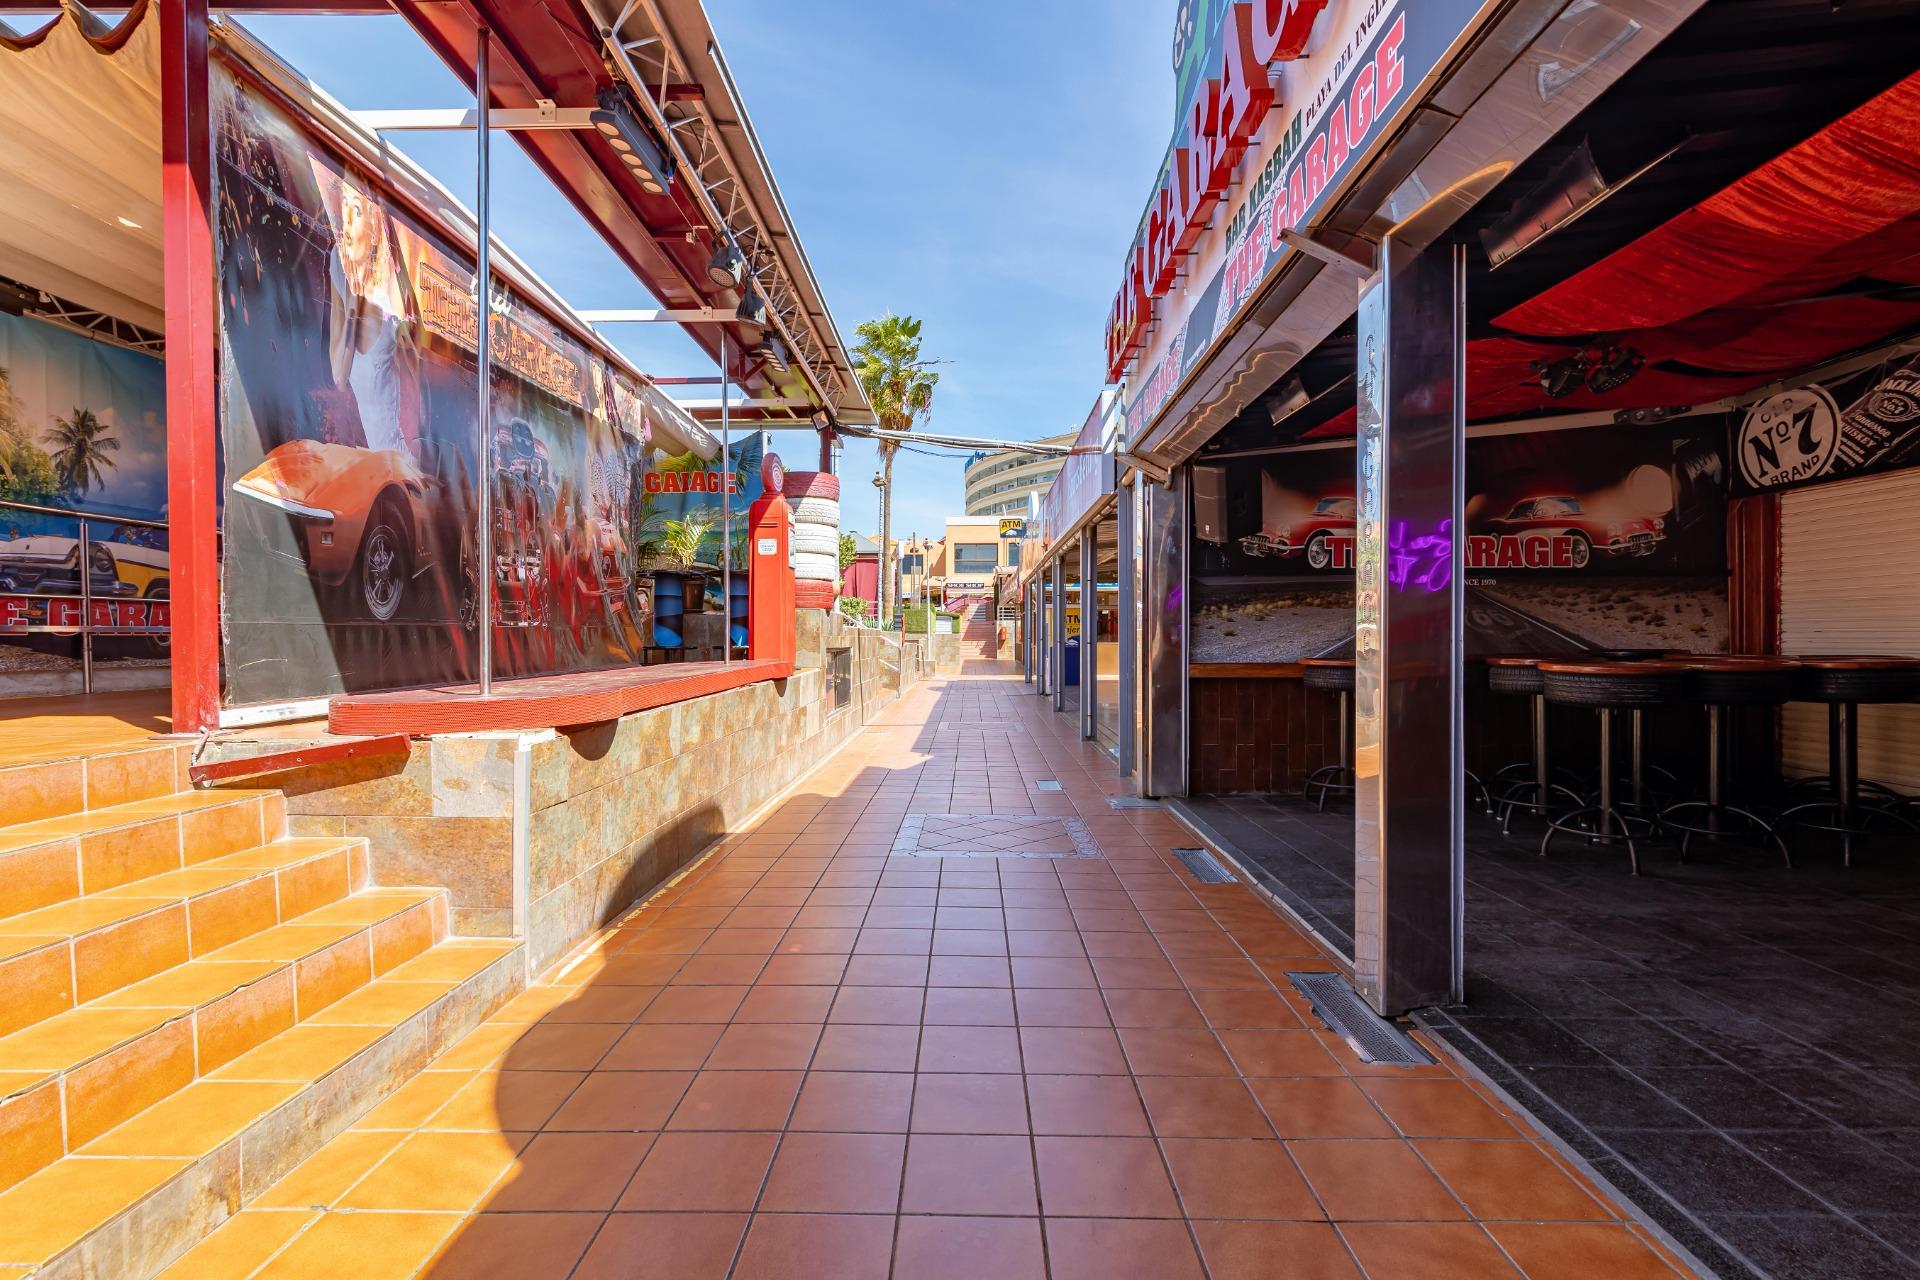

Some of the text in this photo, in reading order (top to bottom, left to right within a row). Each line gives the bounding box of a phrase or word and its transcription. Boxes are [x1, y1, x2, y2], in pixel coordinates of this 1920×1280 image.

[1225, 10, 1406, 310] THE GARAGE
[1226, 202, 1245, 256] BAR
[1249, 108, 1302, 219] KASBAH
[1306, 77, 1332, 127] PLAYA
[1334, 43, 1353, 83] DEL
[1143, 347, 1180, 422] GARAGE
[1770, 454, 1821, 486] BRAND
[1001, 520, 1021, 529] ATM
